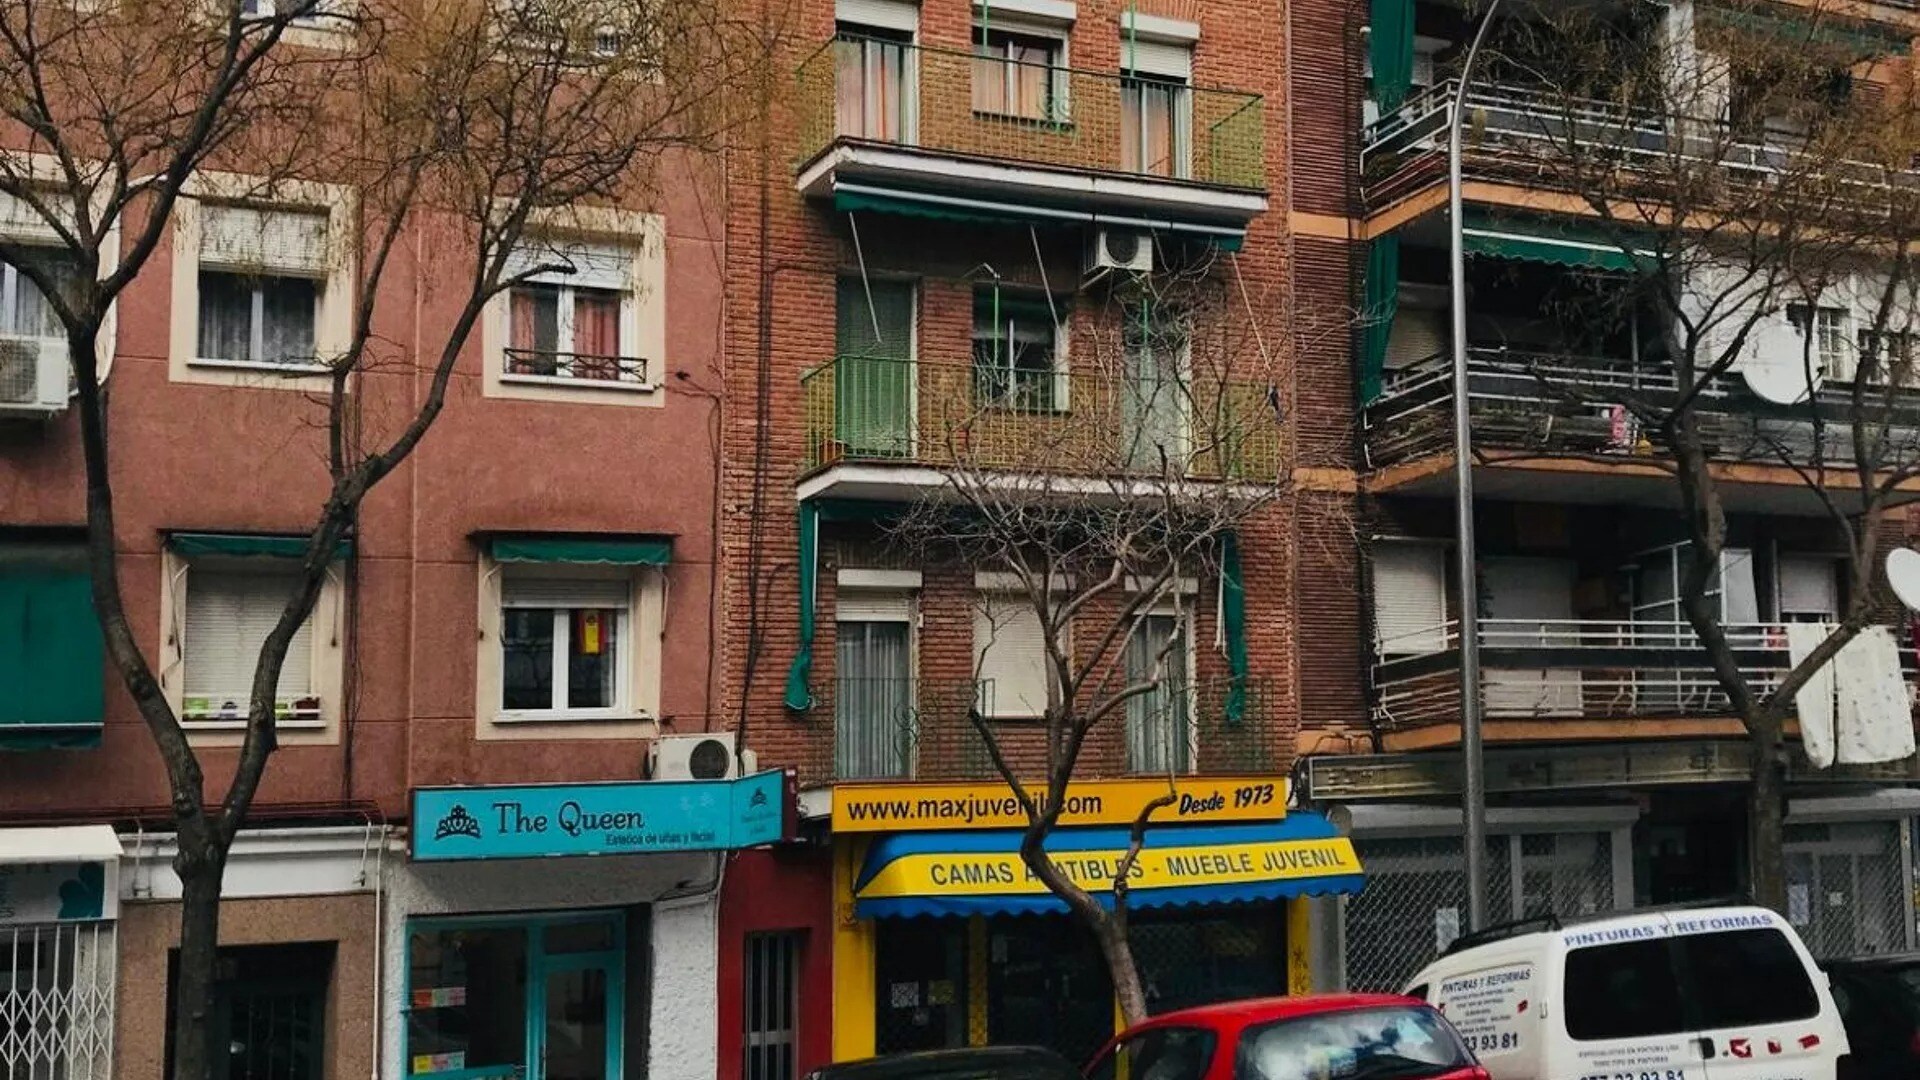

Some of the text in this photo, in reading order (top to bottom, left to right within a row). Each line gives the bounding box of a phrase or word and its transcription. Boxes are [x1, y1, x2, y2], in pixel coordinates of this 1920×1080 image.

[847, 792, 1101, 823] www.maxjuveilom
[1179, 784, 1274, 815] Desde 1973
[492, 801, 645, 837] The Queen
[931, 862, 1014, 885] CAMAS
[1025, 859, 1143, 882] AATIBLES
[1166, 853, 1254, 876] MUEBLE
[1263, 848, 1346, 872] JUVENIL
[1564, 914, 1773, 946] PINTURAS Y REFORMAS
[1441, 978, 1477, 993] PINTURAS
[1486, 968, 1531, 985] REFORMAS
[1481, 1034, 1497, 1050] 93
[1501, 1032, 1518, 1049] 81
